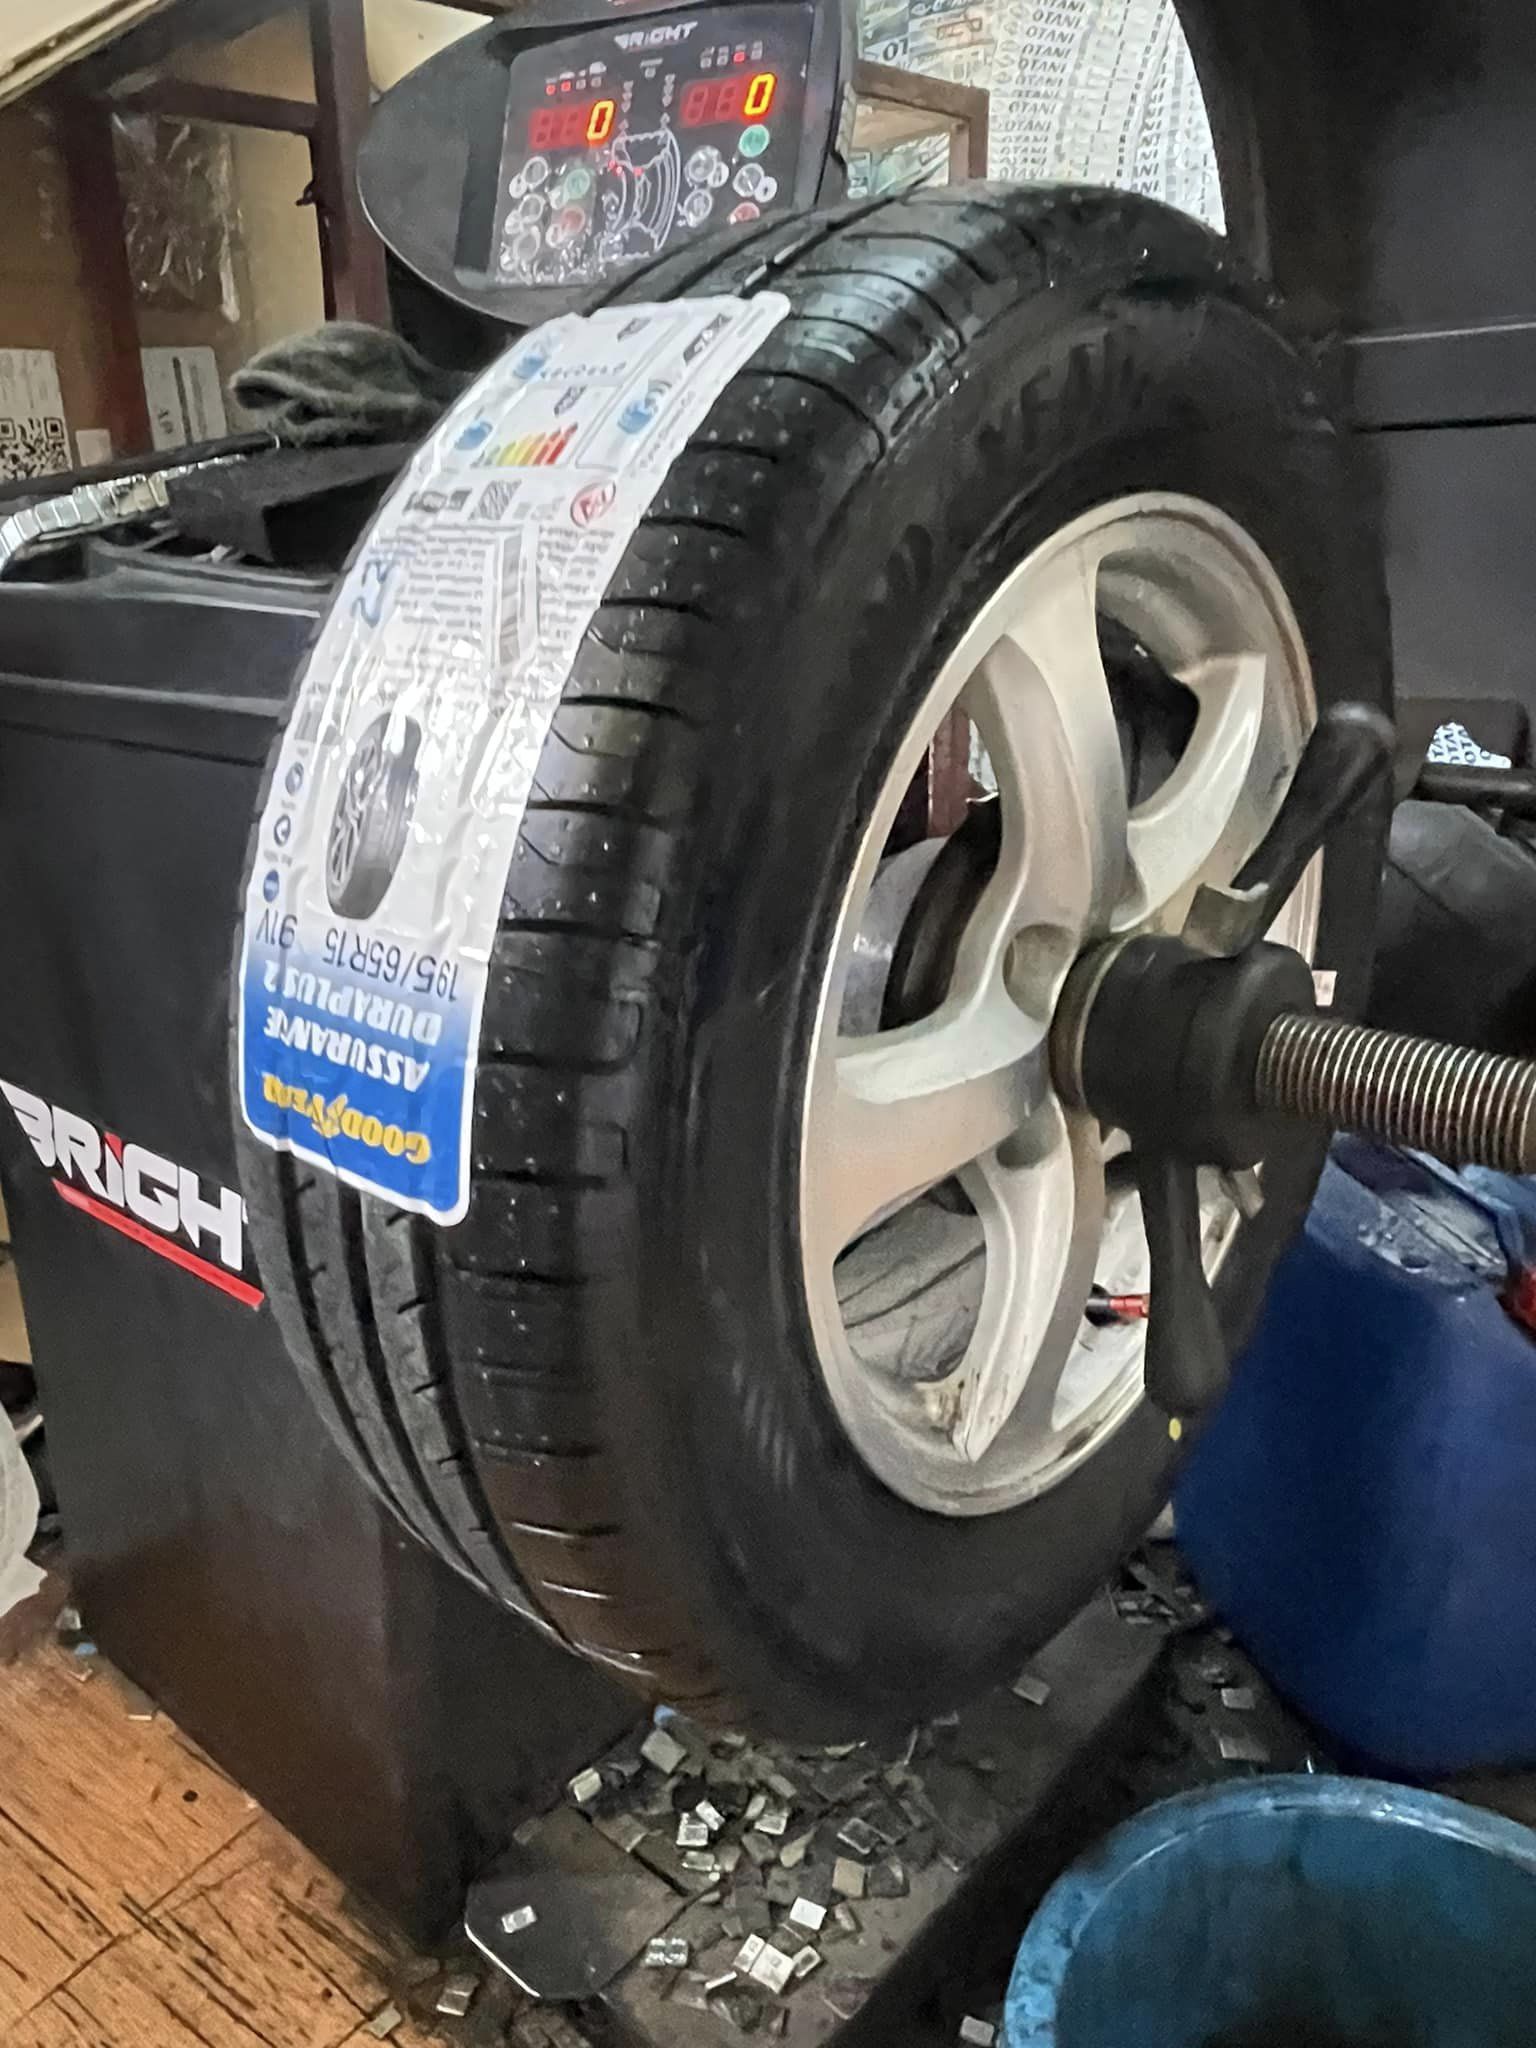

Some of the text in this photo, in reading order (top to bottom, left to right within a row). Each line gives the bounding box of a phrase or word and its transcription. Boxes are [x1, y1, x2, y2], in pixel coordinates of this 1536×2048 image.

[1032, 8, 1081, 29] OTANI
[1025, 25, 1075, 44] OTANI
[1018, 58, 1067, 74] OTANI
[1021, 43, 1071, 59] OTANI
[744, 72, 778, 117] 0
[1008, 101, 1056, 115] OTANI
[586, 99, 616, 141] 0
[256, 908, 460, 1003] 195/65R15 91V
[263, 959, 444, 1047] DURAPLUS 2
[0, 1078, 248, 1272] BRIGH
